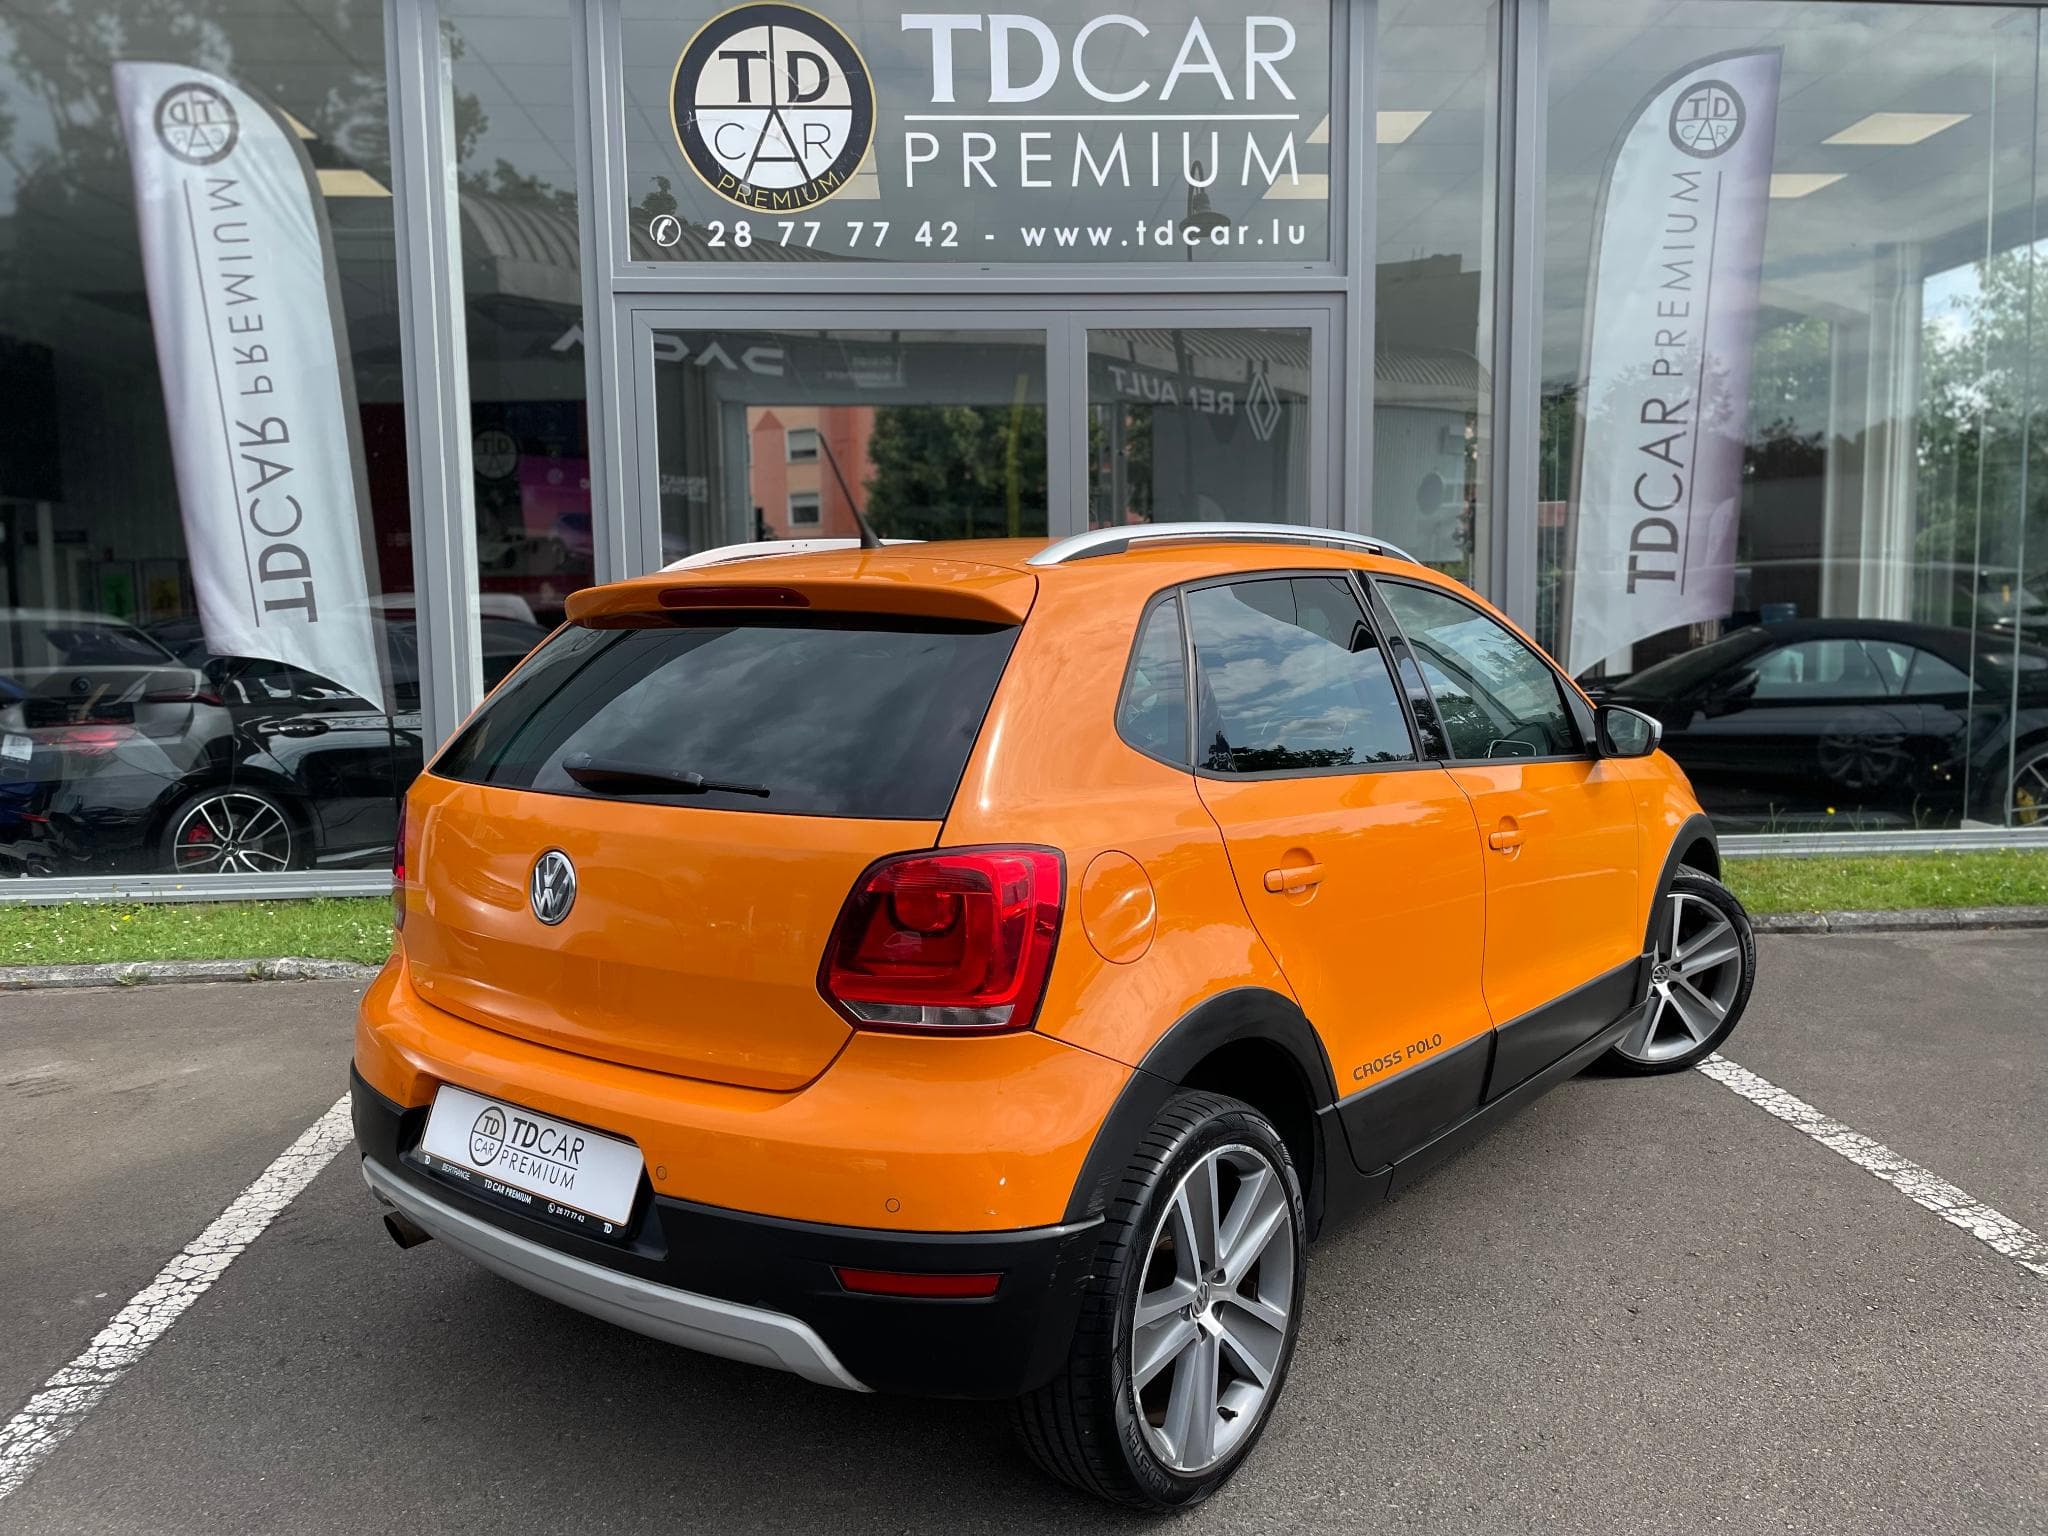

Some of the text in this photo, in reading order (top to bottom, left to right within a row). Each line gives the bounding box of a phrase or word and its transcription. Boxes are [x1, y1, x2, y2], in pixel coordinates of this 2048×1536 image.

[901, 13, 1297, 103] TDCAR
[905, 131, 1300, 188] PREMIUM
[717, 170, 841, 210] PREMIUM
[707, 220, 752, 247] 28
[777, 221, 821, 247] 77
[847, 221, 890, 247] 77
[914, 221, 958, 247] 42
[1020, 218, 1306, 247] www.tdcar.lu
[1626, 171, 1702, 595] TDCAR PREMIUM
[1353, 1034, 1442, 1081] CROSS POLO
[483, 1116, 500, 1136] TD
[511, 1117, 585, 1165] TDCAR
[474, 1138, 495, 1156] CAR
[493, 1182, 505, 1196] CAR
[499, 1149, 575, 1190] PREMIUM
